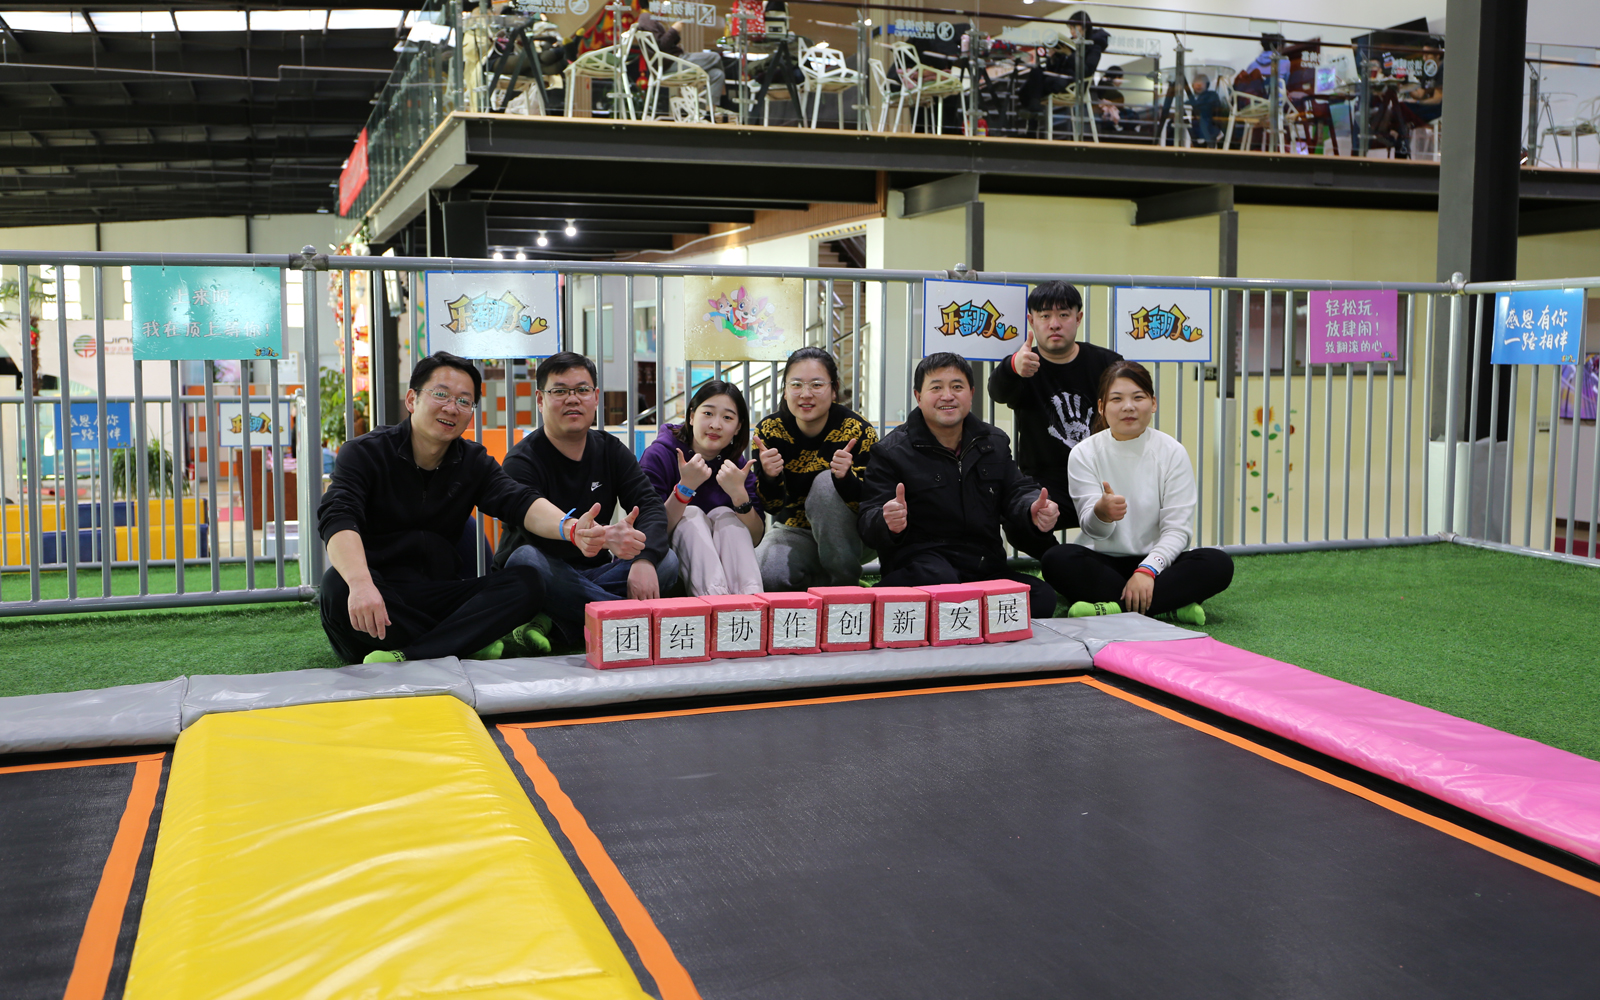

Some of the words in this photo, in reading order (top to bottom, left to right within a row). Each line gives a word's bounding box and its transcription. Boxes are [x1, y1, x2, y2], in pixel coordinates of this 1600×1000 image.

[1325, 298, 1379, 317] 轻松玩，
[1505, 304, 1568, 330] 感恩有你
[141, 319, 270, 339] 我在顶上等你！
[938, 299, 1001, 339] 乐翻了
[1129, 303, 1187, 340] 乐翻了
[1325, 319, 1380, 338] 放肆闹！
[1324, 340, 1383, 355] 致翻滚的心
[1504, 329, 1569, 352] 一路相伴
